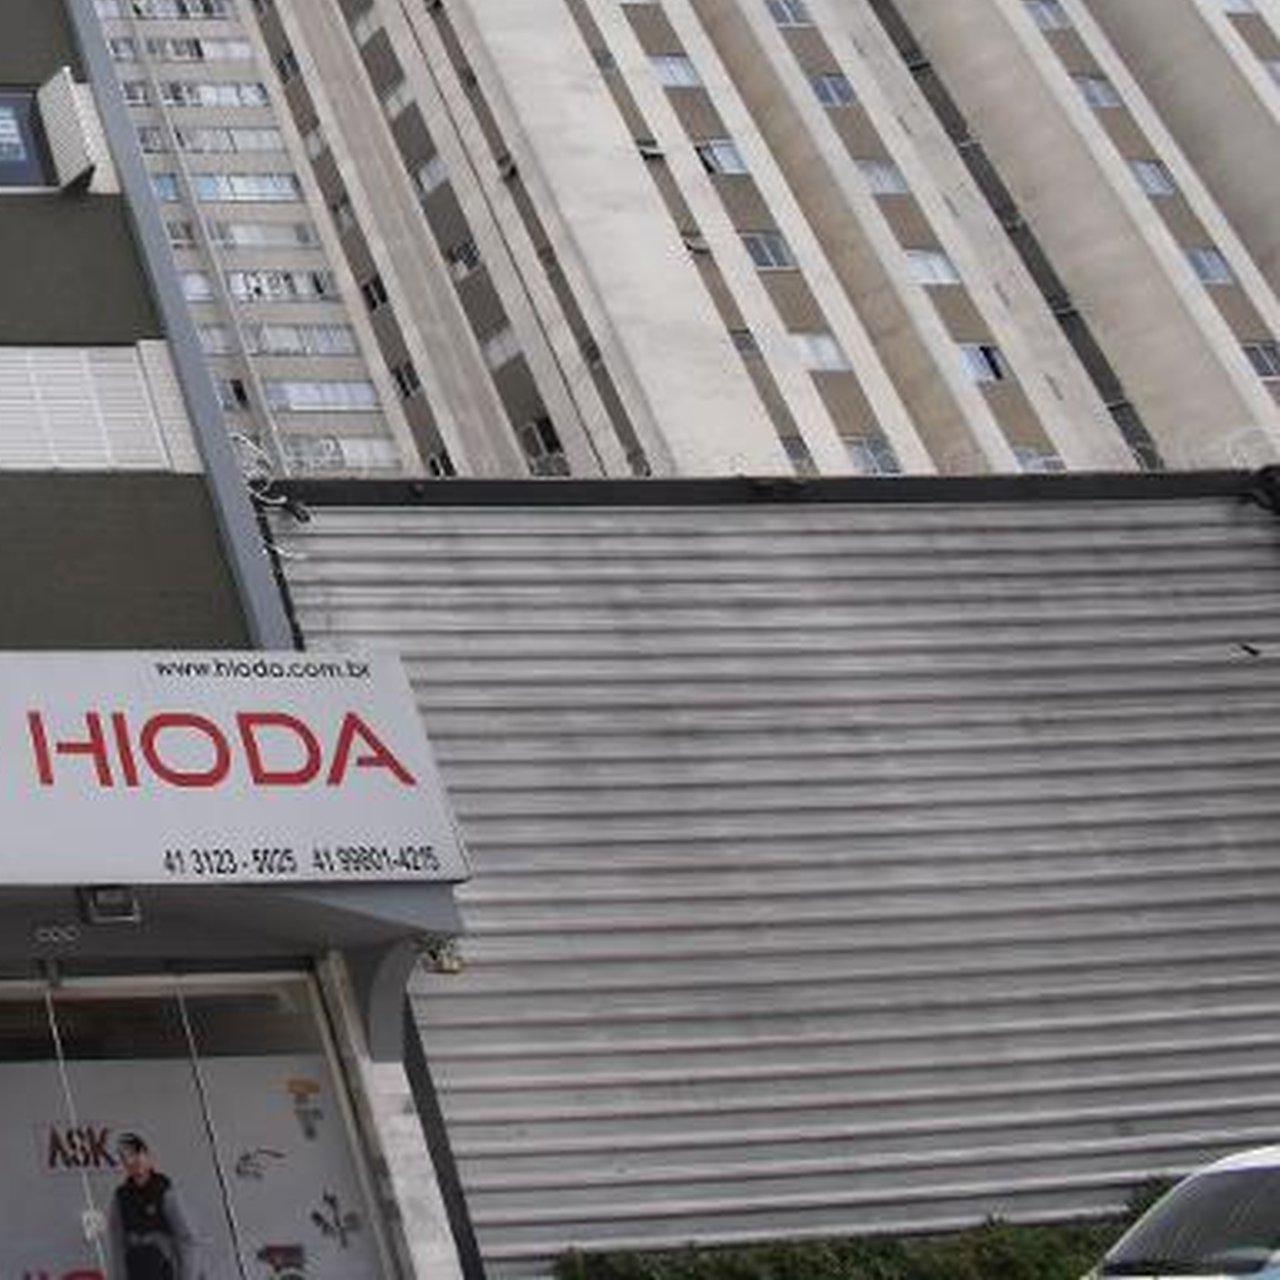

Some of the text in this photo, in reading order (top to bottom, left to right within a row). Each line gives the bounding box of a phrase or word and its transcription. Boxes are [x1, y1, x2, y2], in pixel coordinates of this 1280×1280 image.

[155, 659, 371, 677] www.hioda.com.br
[27, 711, 417, 787] HIODA
[164, 849, 185, 873] 41
[48, 1125, 120, 1169] ASK
